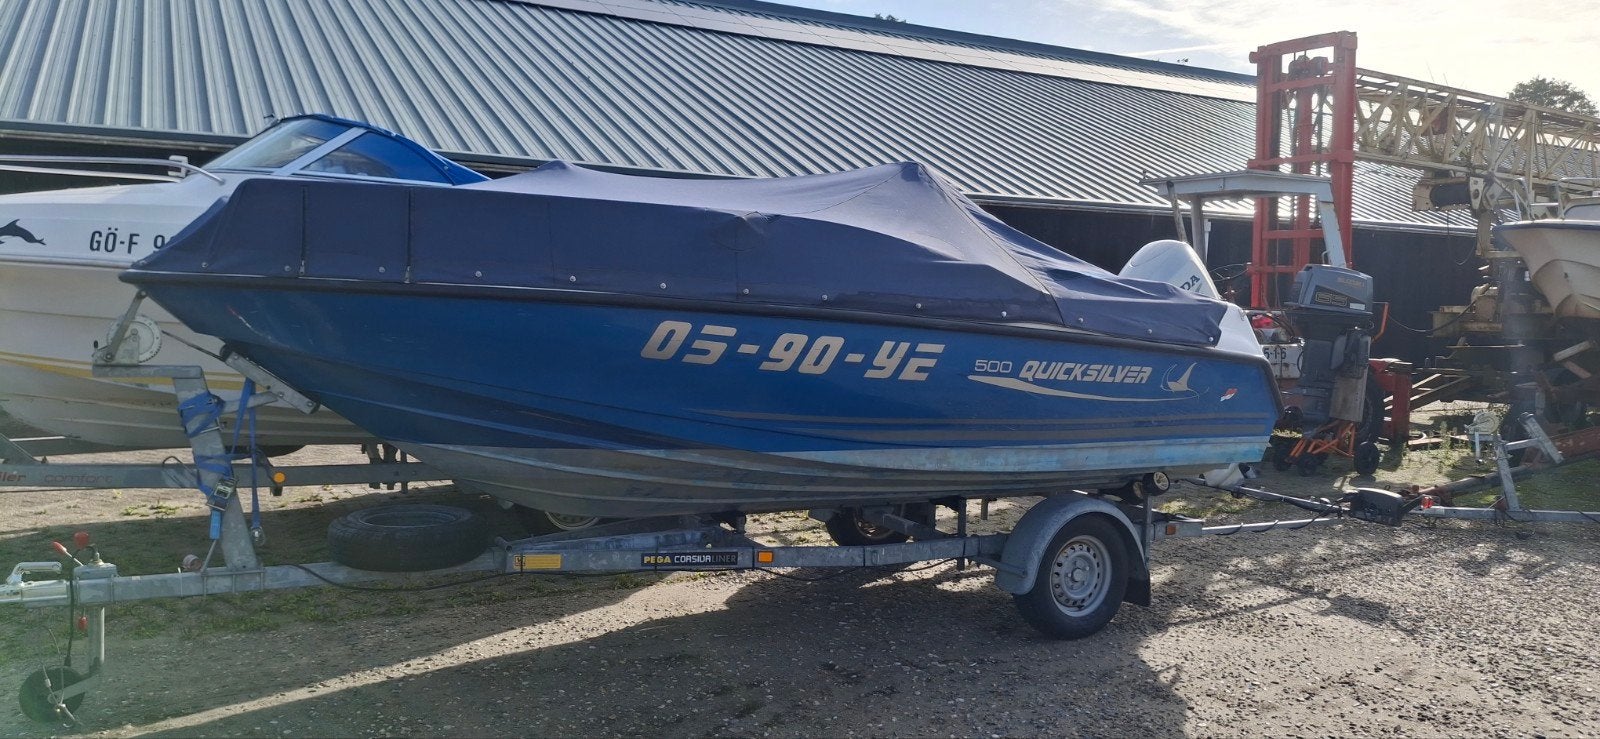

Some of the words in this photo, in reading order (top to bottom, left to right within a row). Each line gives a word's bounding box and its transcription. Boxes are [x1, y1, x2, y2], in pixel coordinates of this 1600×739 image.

[89, 227, 140, 254] GÖ-F
[641, 320, 946, 381] 05-90-YE
[974, 359, 1013, 374] 500
[1018, 360, 1153, 384] QUICKSILVER
[643, 555, 671, 565] PEGA
